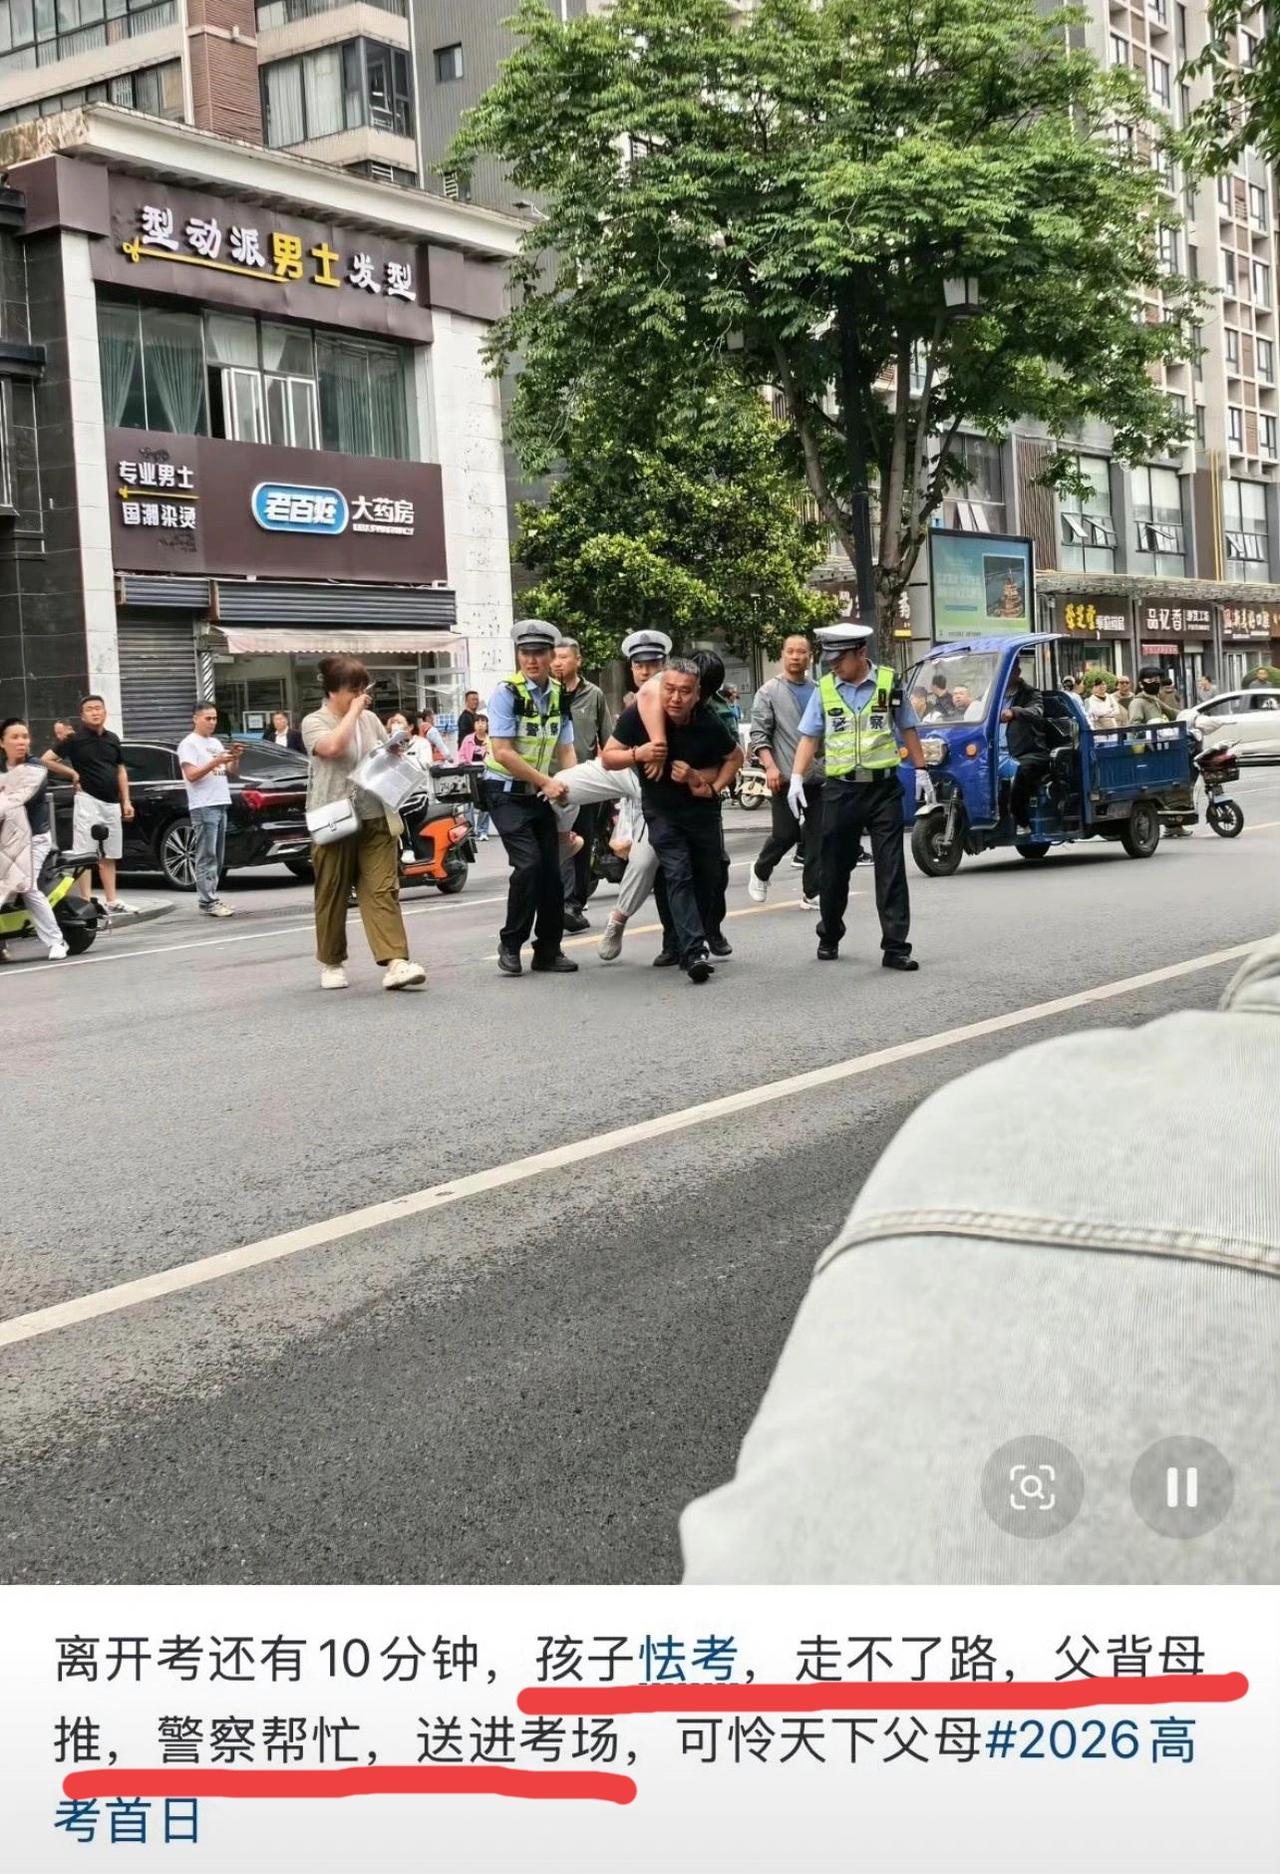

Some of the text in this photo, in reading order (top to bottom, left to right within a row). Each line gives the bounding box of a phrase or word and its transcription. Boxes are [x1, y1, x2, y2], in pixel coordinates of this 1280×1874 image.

[141, 205, 416, 300] 型动派男士发型
[119, 461, 194, 488] 专业男士
[122, 501, 196, 529] 国潮染烫
[351, 496, 415, 524] 大药房
